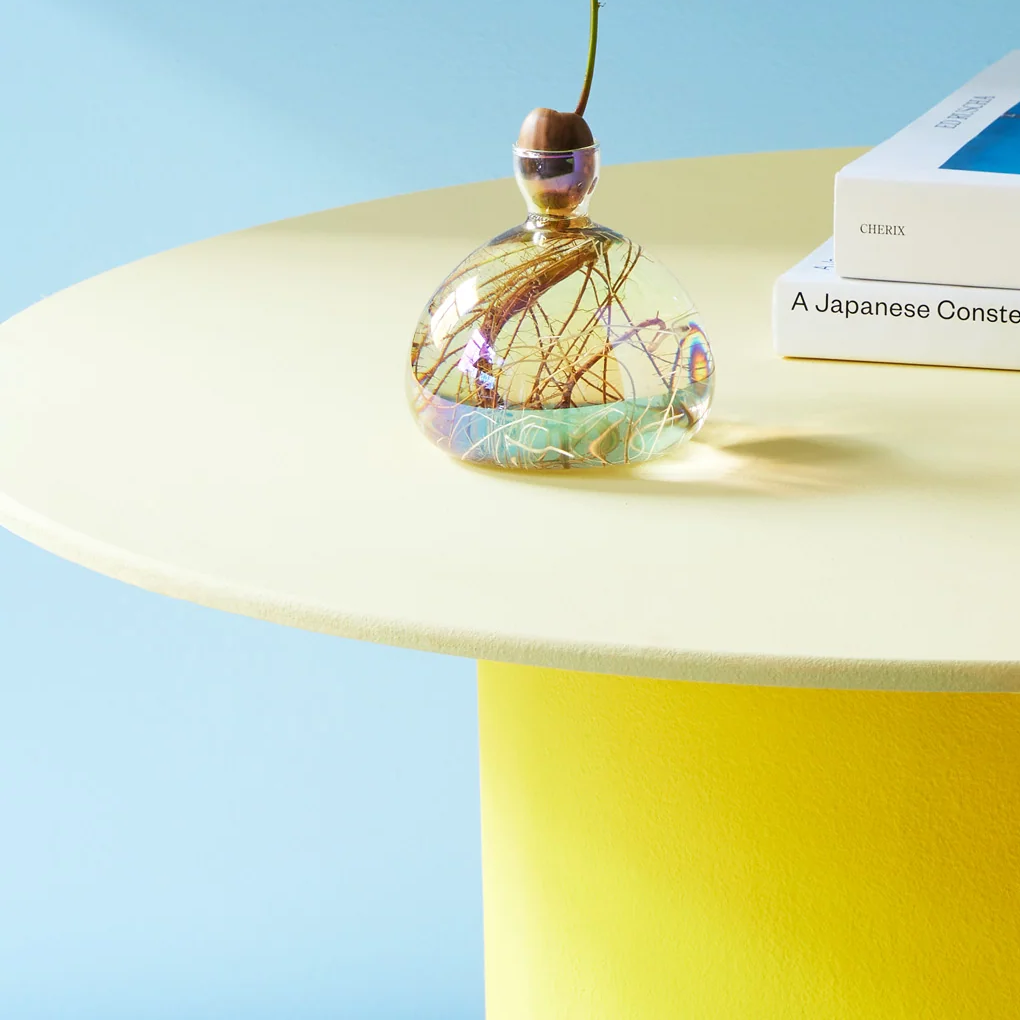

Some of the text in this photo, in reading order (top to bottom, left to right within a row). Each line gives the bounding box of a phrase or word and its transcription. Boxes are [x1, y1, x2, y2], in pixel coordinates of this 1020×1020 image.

[859, 223, 906, 236] CHERIX
[791, 291, 809, 312] A
[815, 292, 931, 319] Japanese
